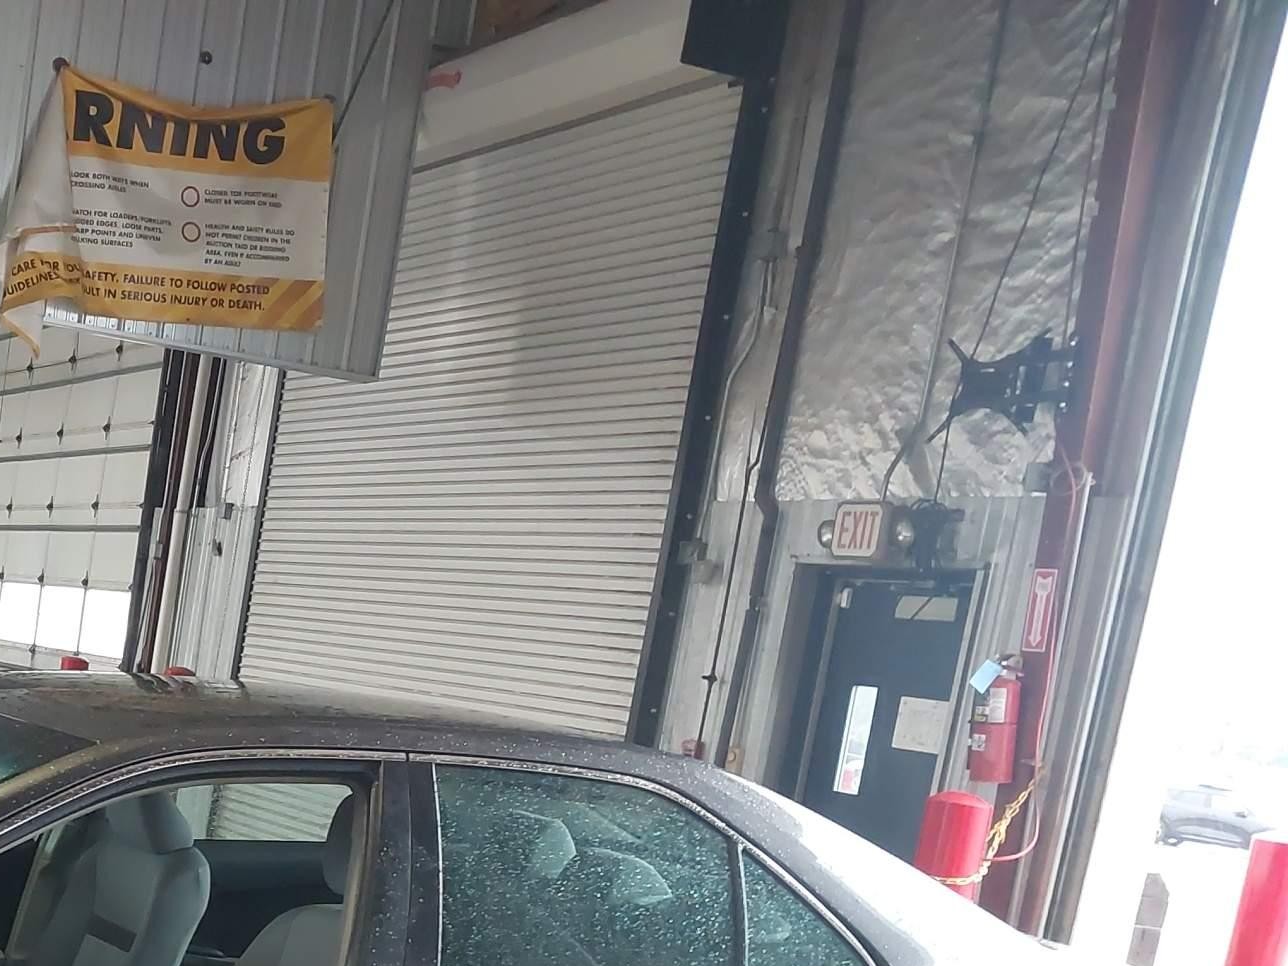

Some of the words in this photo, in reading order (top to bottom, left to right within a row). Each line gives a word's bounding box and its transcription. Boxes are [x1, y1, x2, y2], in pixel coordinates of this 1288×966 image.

[91, 229, 116, 237] POINTS
[118, 231, 134, 239] AND
[122, 222, 142, 230] LOOSE
[101, 239, 133, 248] SURFACES
[12, 259, 37, 276] CARE
[83, 270, 120, 283] AFETY.
[123, 273, 166, 287] FAILURE
[169, 278, 183, 288] TO
[186, 280, 227, 292] FOLLOW
[230, 283, 270, 295] POSTED
[83, 286, 100, 297] ULT
[104, 288, 117, 299] IN
[120, 290, 167, 303] SERIOUS
[170, 294, 208, 307] INJURY
[210, 298, 225, 309] OR
[228, 299, 265, 311] DEATH.
[837, 511, 880, 549] EXIT
